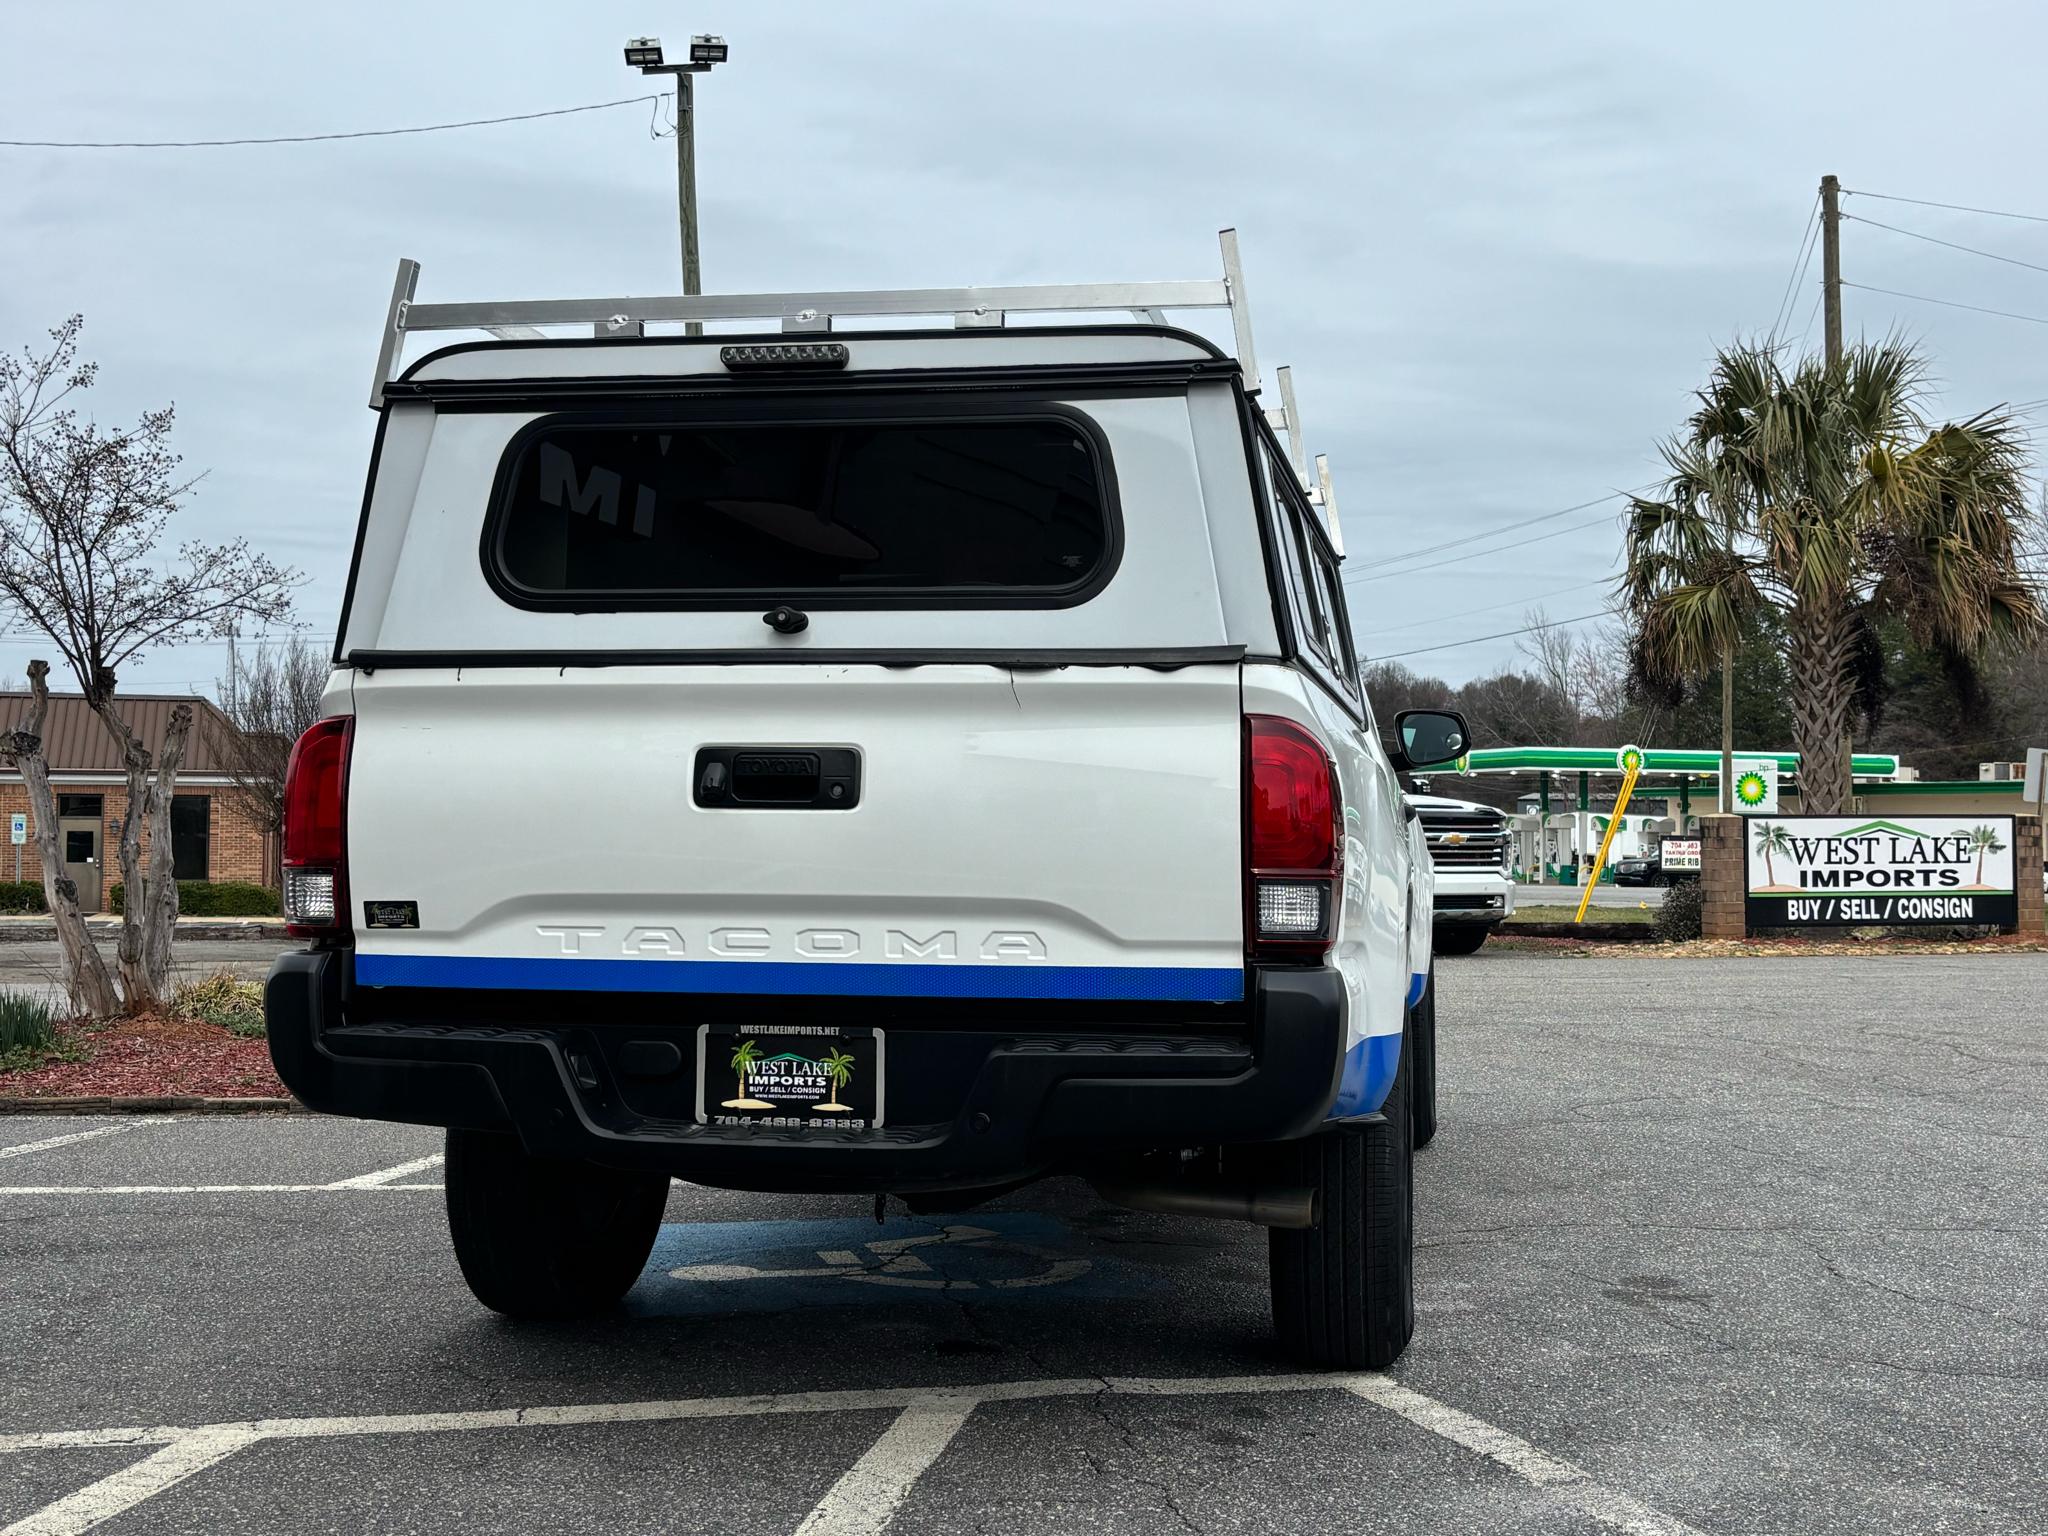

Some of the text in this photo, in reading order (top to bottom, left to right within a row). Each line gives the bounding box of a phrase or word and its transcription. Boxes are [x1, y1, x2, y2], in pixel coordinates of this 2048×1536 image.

[739, 758, 812, 774] TOYOTA
[1788, 836, 1972, 866] WEST LAKE
[1665, 857, 1699, 866] PRIME RIB
[1799, 869, 1960, 888] IMPORTS
[1787, 899, 1821, 921] BUY
[1840, 898, 1881, 920] SELL
[1897, 897, 1974, 920] CONSIGN
[535, 925, 1048, 961] TACOMA
[740, 1025, 840, 1036] WESTLAKEIMPORTS.NET
[745, 1061, 833, 1076] WEST LAKE
[748, 1076, 827, 1086] IMPORTS
